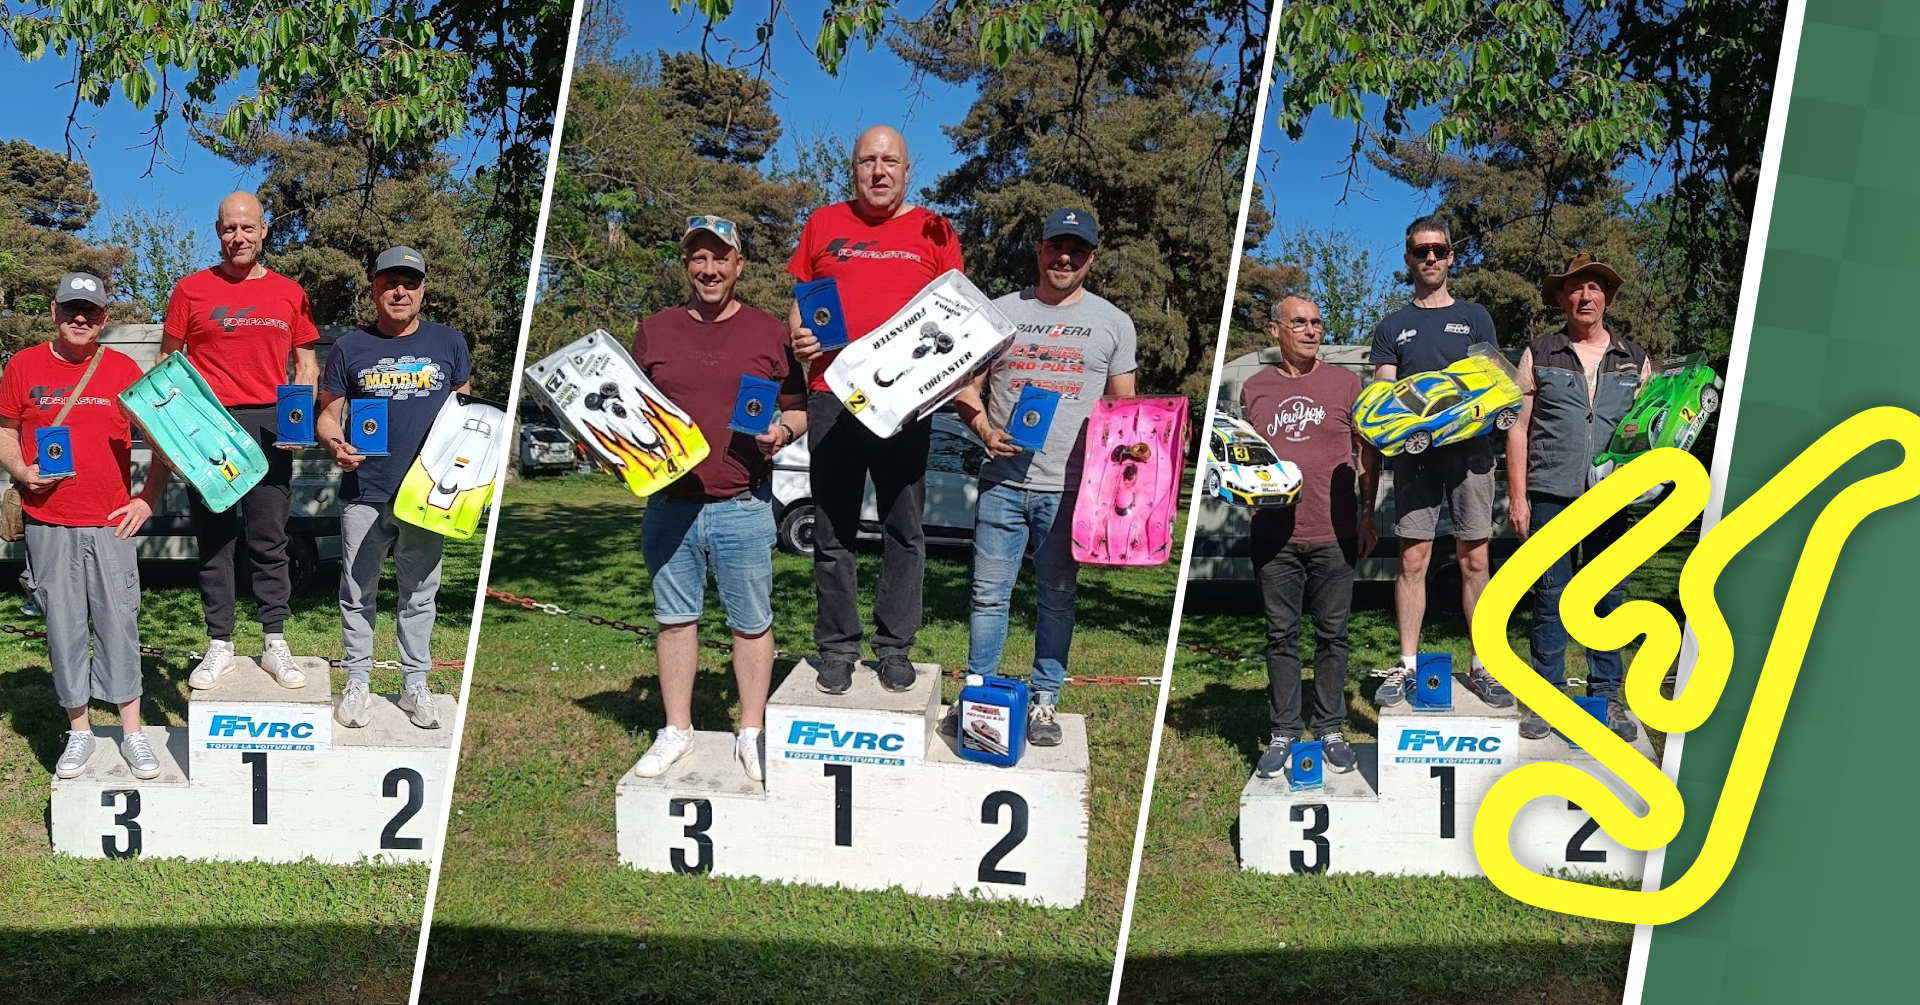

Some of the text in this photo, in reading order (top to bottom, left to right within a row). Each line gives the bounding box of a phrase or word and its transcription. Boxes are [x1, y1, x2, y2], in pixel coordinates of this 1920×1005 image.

[838, 248, 922, 263] FORFASTER
[224, 317, 289, 332] FORFASTER
[872, 307, 927, 350] FORFASTER
[1016, 323, 1092, 338] PANTHERA
[918, 351, 973, 395] FORFASTER
[1008, 361, 1085, 373] PRO-PULSE
[364, 370, 432, 389] MATRIX
[850, 394, 866, 409] 2
[1475, 405, 1480, 417] 1
[1682, 408, 1693, 421] 2
[1237, 448, 1246, 459] 3
[224, 464, 234, 478] 1
[667, 458, 678, 473] 4
[208, 715, 315, 738] FFVRC
[787, 721, 905, 752] FFVRC
[1397, 730, 1502, 752] FFVRC
[243, 752, 268, 825] 1
[381, 768, 423, 849] 2
[824, 764, 852, 846] 1
[1431, 767, 1455, 838] 1
[101, 790, 142, 858] 3
[670, 799, 713, 875] 3
[978, 791, 1029, 885] 2
[1290, 804, 1330, 875] 3
